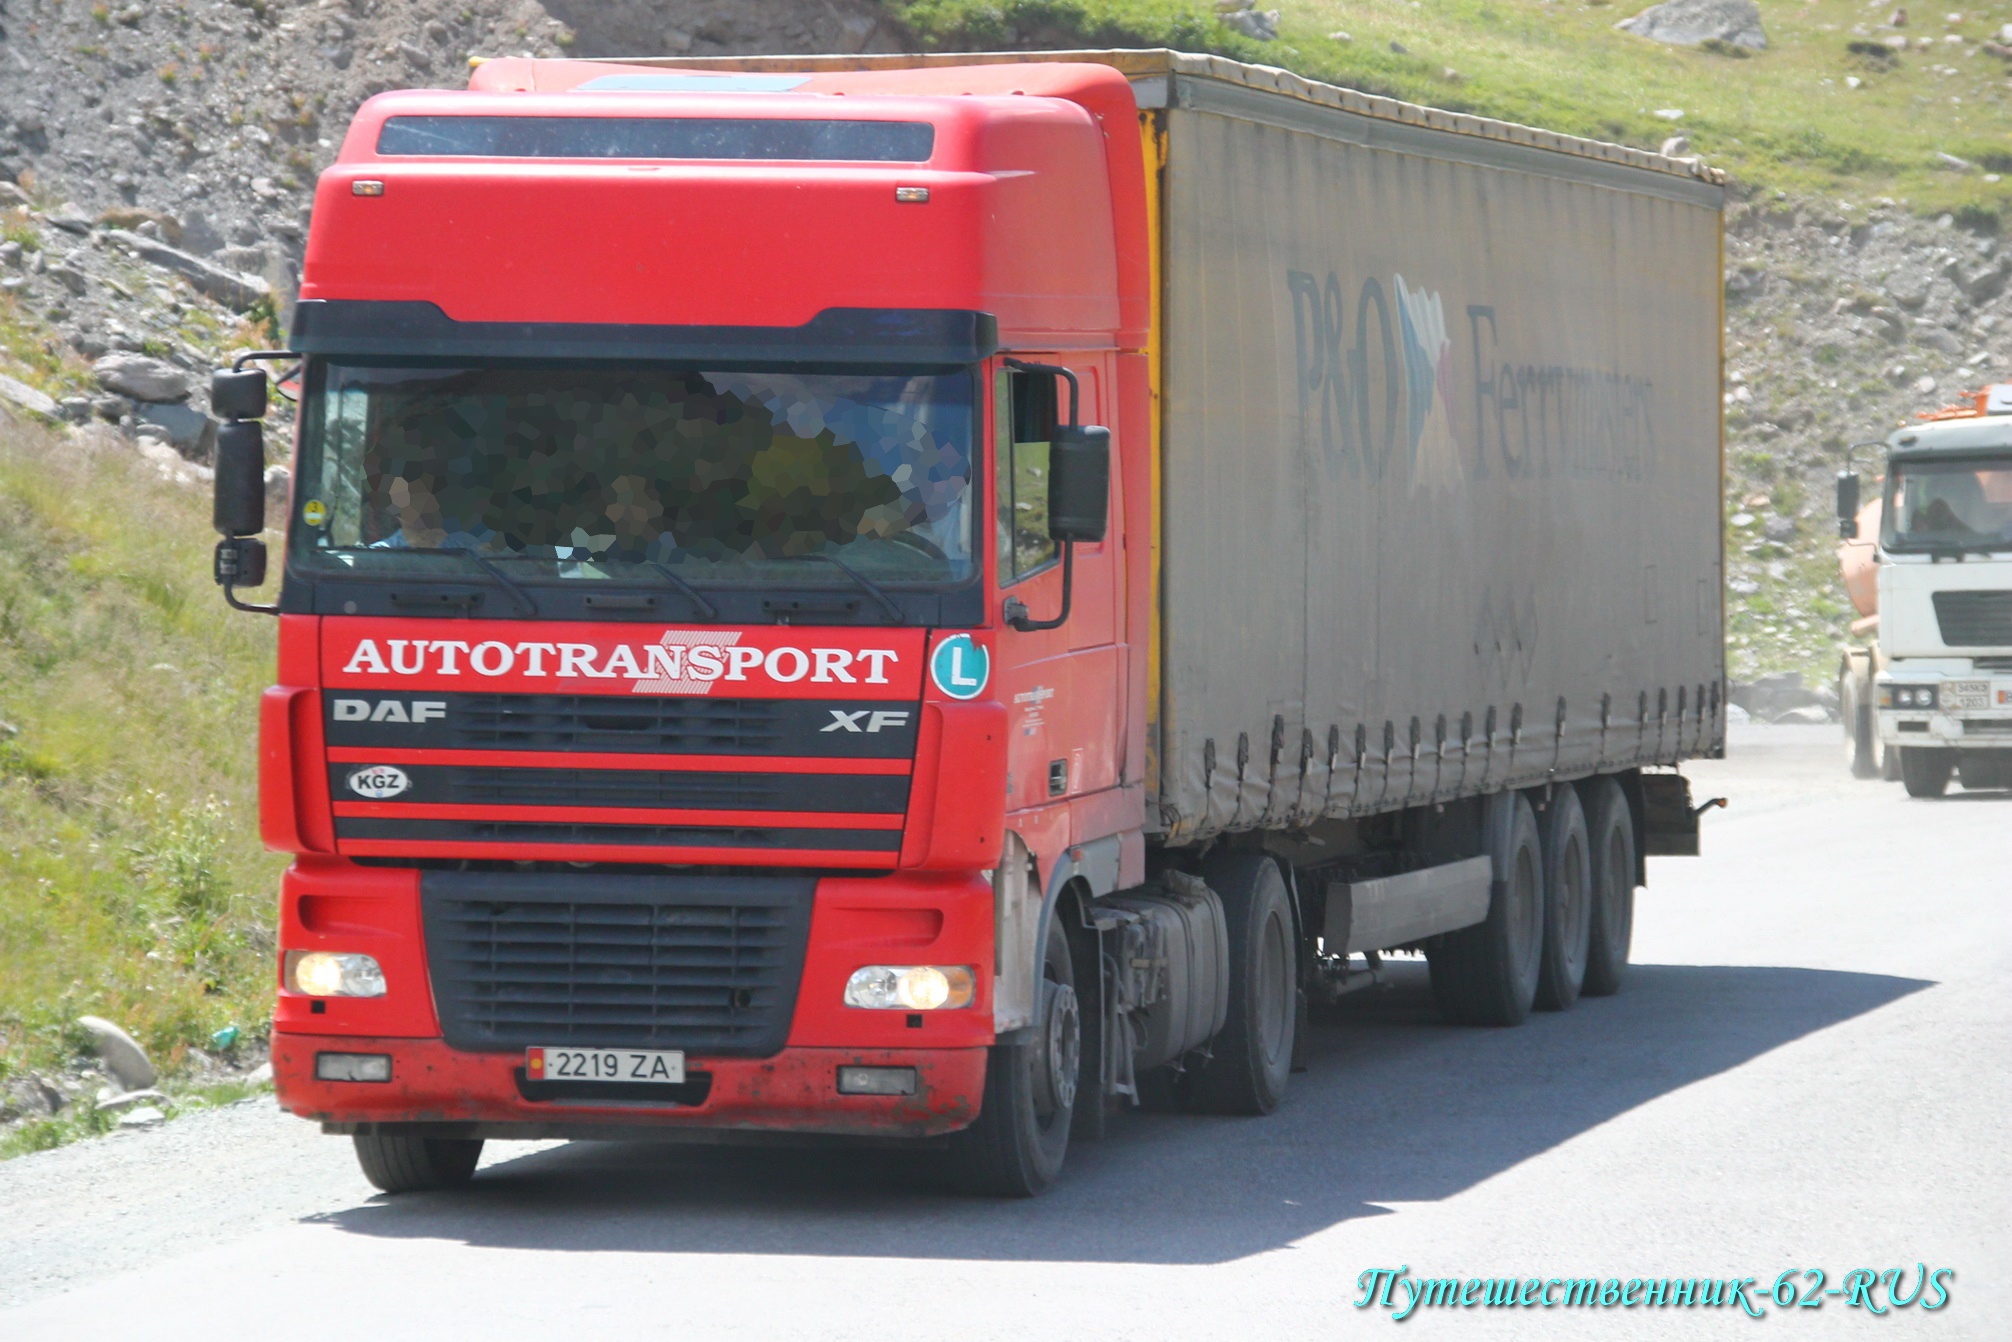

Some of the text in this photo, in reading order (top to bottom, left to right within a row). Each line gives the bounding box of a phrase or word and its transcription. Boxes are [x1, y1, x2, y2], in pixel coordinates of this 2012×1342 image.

[1287, 269, 1399, 481] P&O
[341, 638, 900, 685] AUTOTRANSPORT
[951, 647, 977, 687] L
[333, 699, 447, 724] DAF
[819, 710, 910, 733] XF
[357, 773, 400, 790] KGZ
[556, 1052, 670, 1079] 2219 ZA
